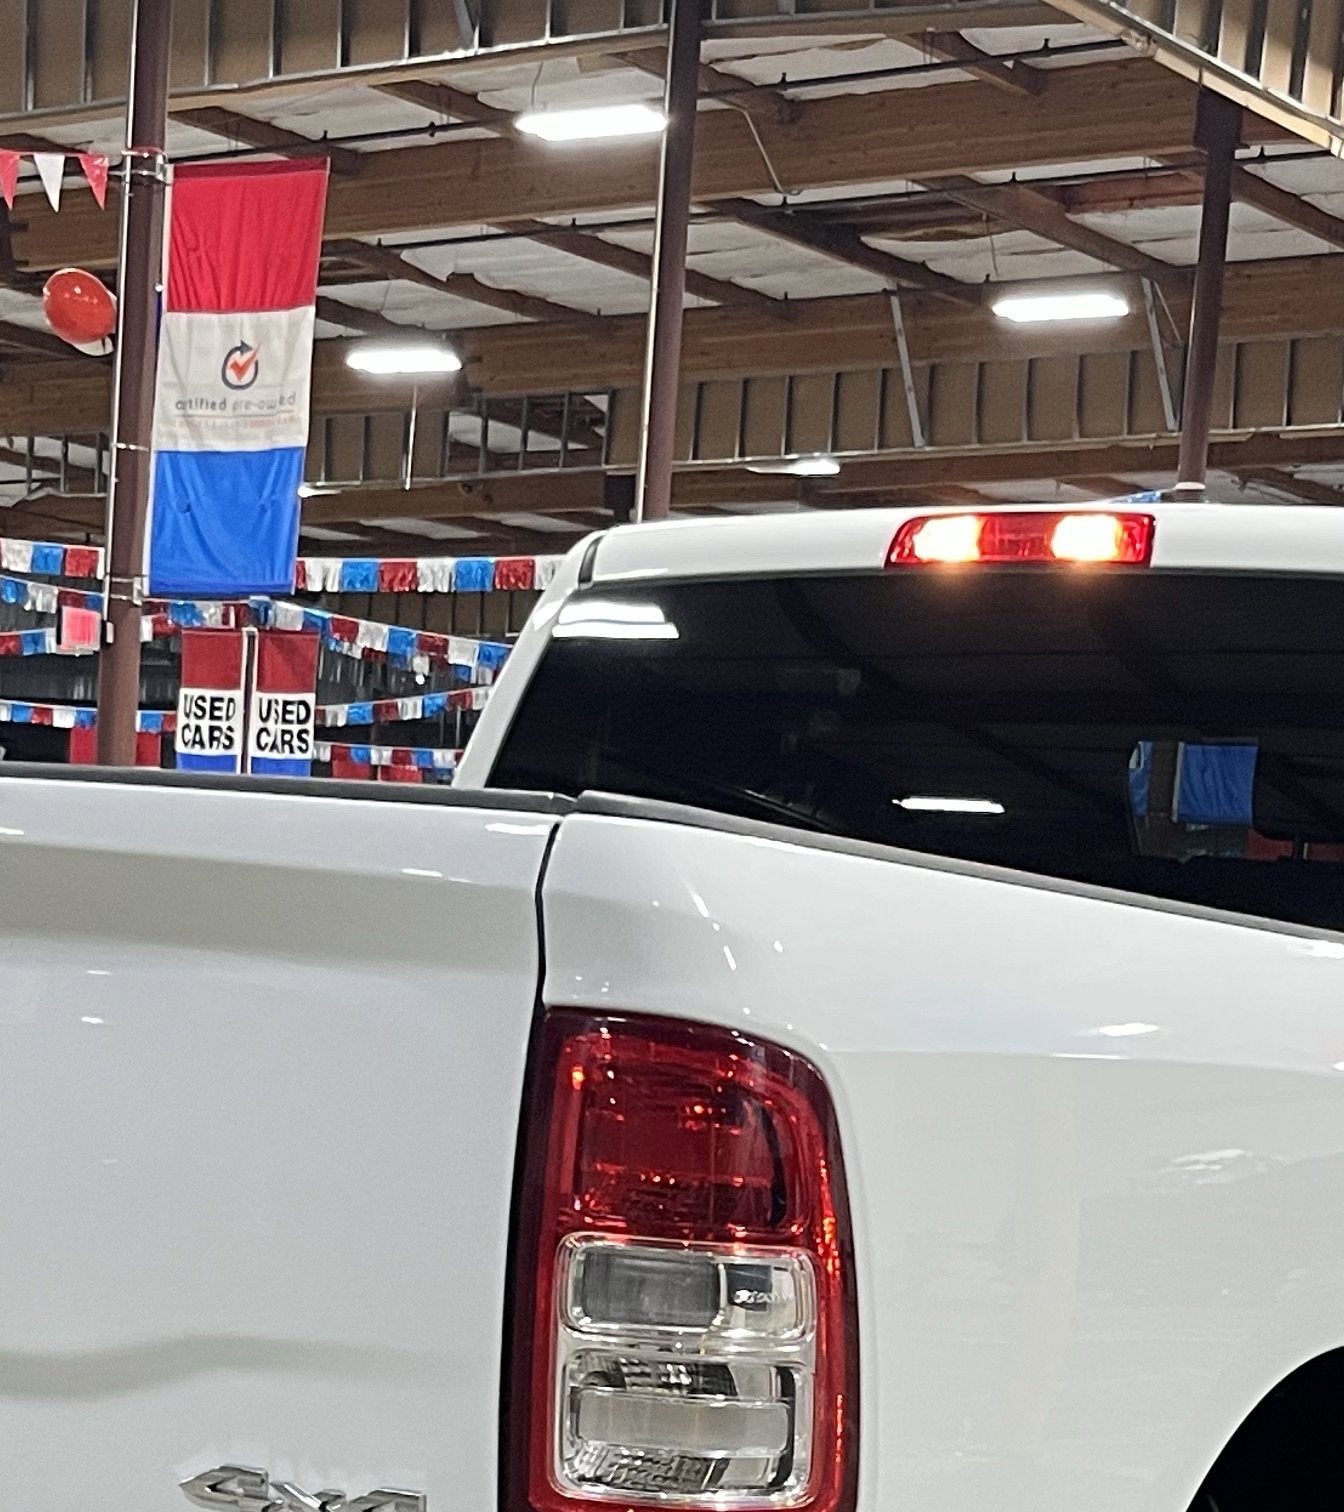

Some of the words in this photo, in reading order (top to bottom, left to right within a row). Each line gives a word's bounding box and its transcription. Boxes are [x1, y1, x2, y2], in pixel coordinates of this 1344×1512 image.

[182, 693, 236, 722] USED
[258, 696, 311, 725] USED
[180, 722, 235, 751] CARS
[256, 726, 310, 754] CARS
